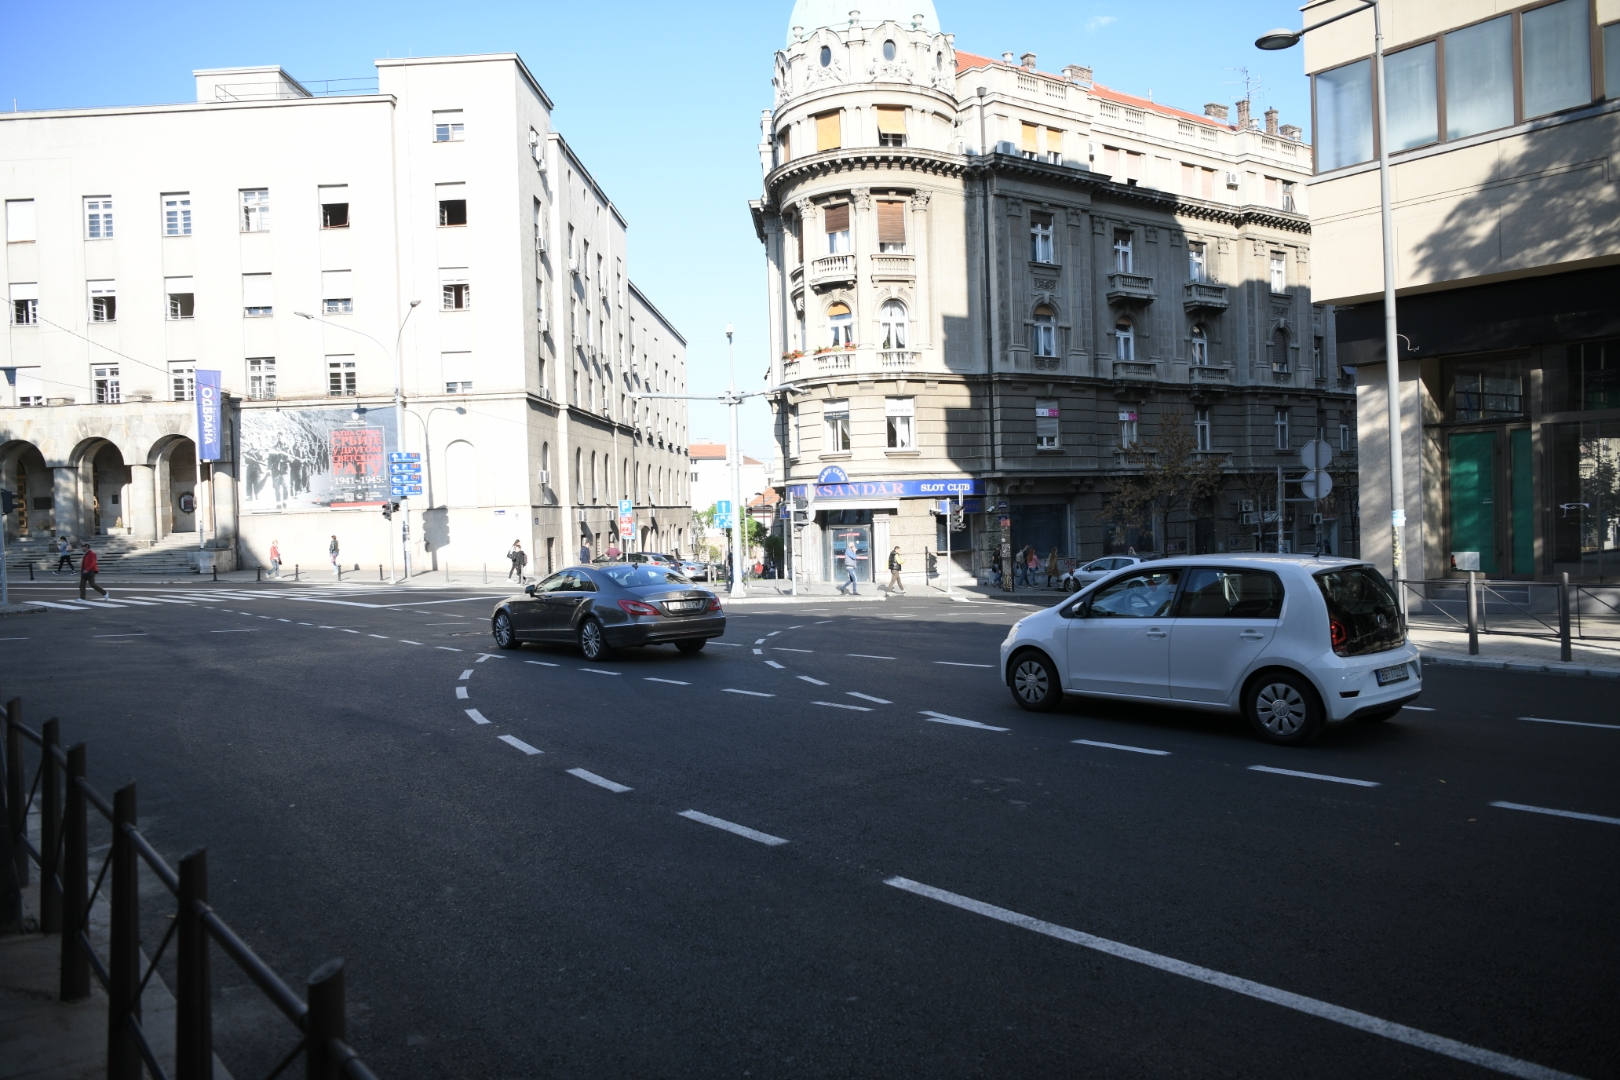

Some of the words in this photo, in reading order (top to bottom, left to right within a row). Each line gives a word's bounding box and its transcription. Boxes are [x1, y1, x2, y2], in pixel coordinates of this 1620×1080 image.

[201, 387, 213, 444] ОДБРАНА
[330, 435, 382, 446] СРБИЈЕ
[341, 446, 382, 454] ДРУГОМ
[332, 454, 382, 462] СВЕТСКОМ
[333, 462, 382, 476] РАТУ
[920, 484, 945, 492] SLOT
[947, 483, 970, 491] CLUB
[621, 502, 629, 511] P
